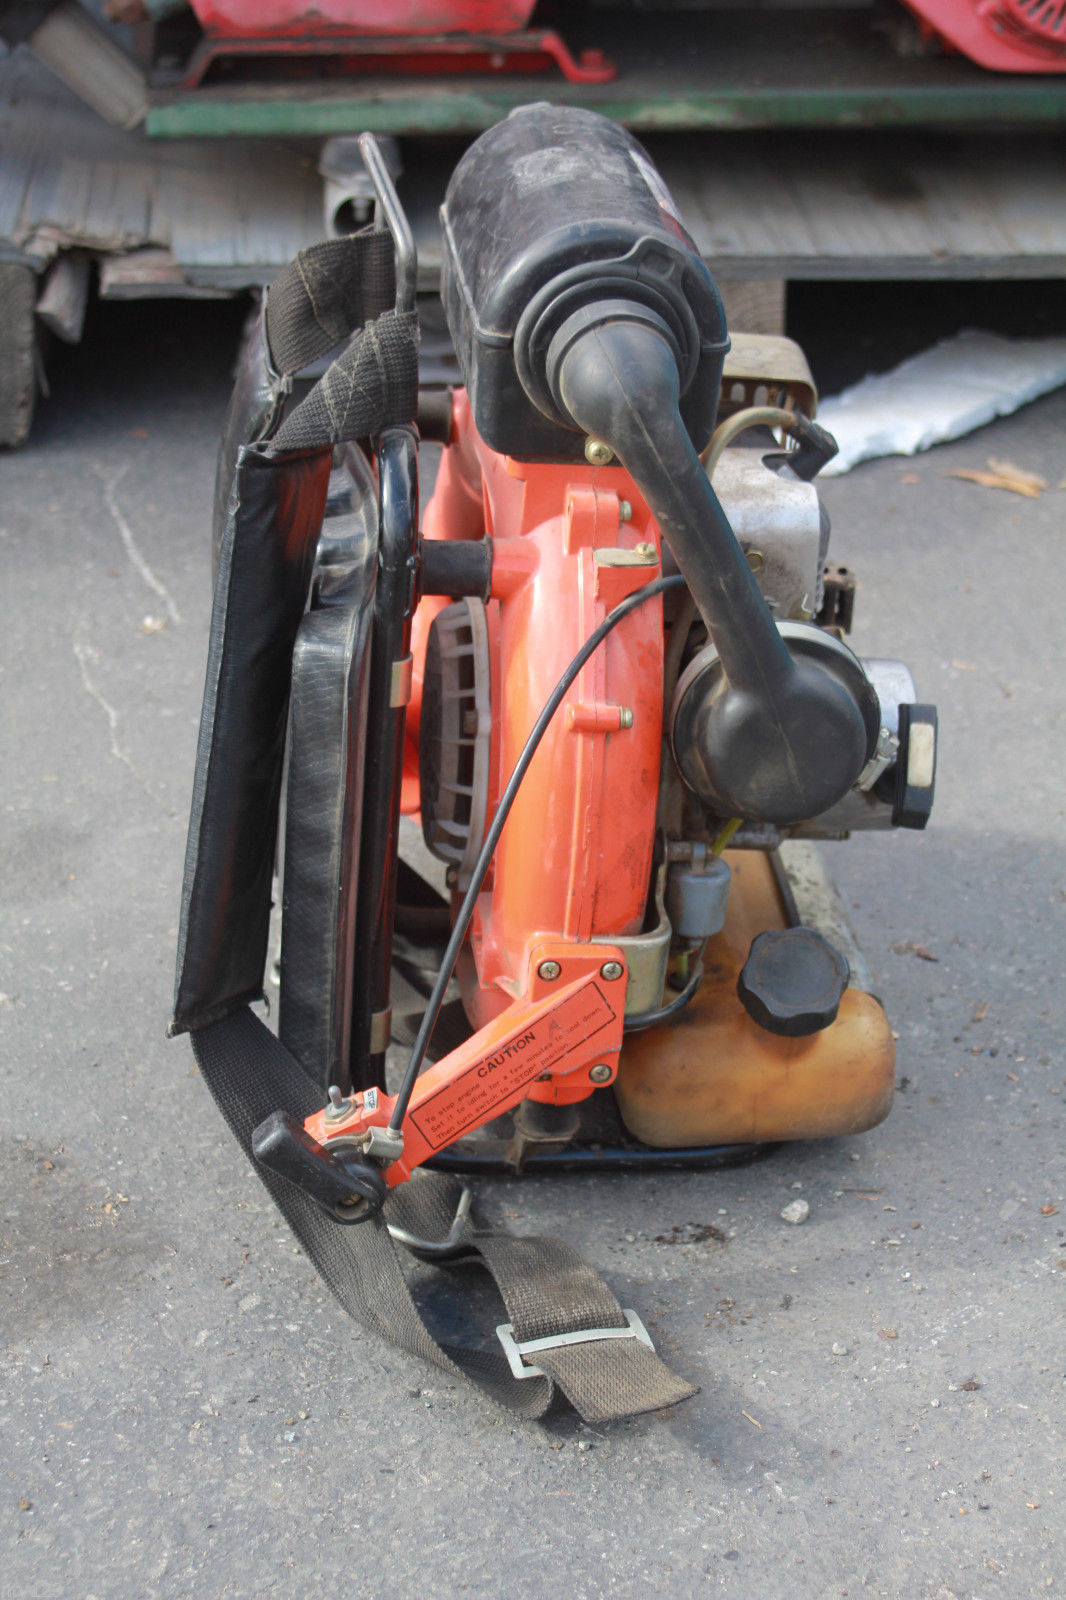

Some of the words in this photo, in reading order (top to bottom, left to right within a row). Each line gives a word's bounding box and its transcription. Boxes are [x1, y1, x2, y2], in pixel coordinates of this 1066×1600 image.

[475, 1032, 536, 1078] CAUTION
[368, 1091, 376, 1109] STOP
[430, 1120, 444, 1132] Set
[456, 1105, 466, 1114] to
[488, 1079, 500, 1090] for
[508, 1062, 524, 1075] few
[524, 1041, 553, 1064] minutes
[424, 1113, 436, 1125] To
[437, 1101, 455, 1116] stop
[435, 1124, 456, 1140] Then
[456, 1112, 473, 1126] turn
[499, 1085, 509, 1094] to
